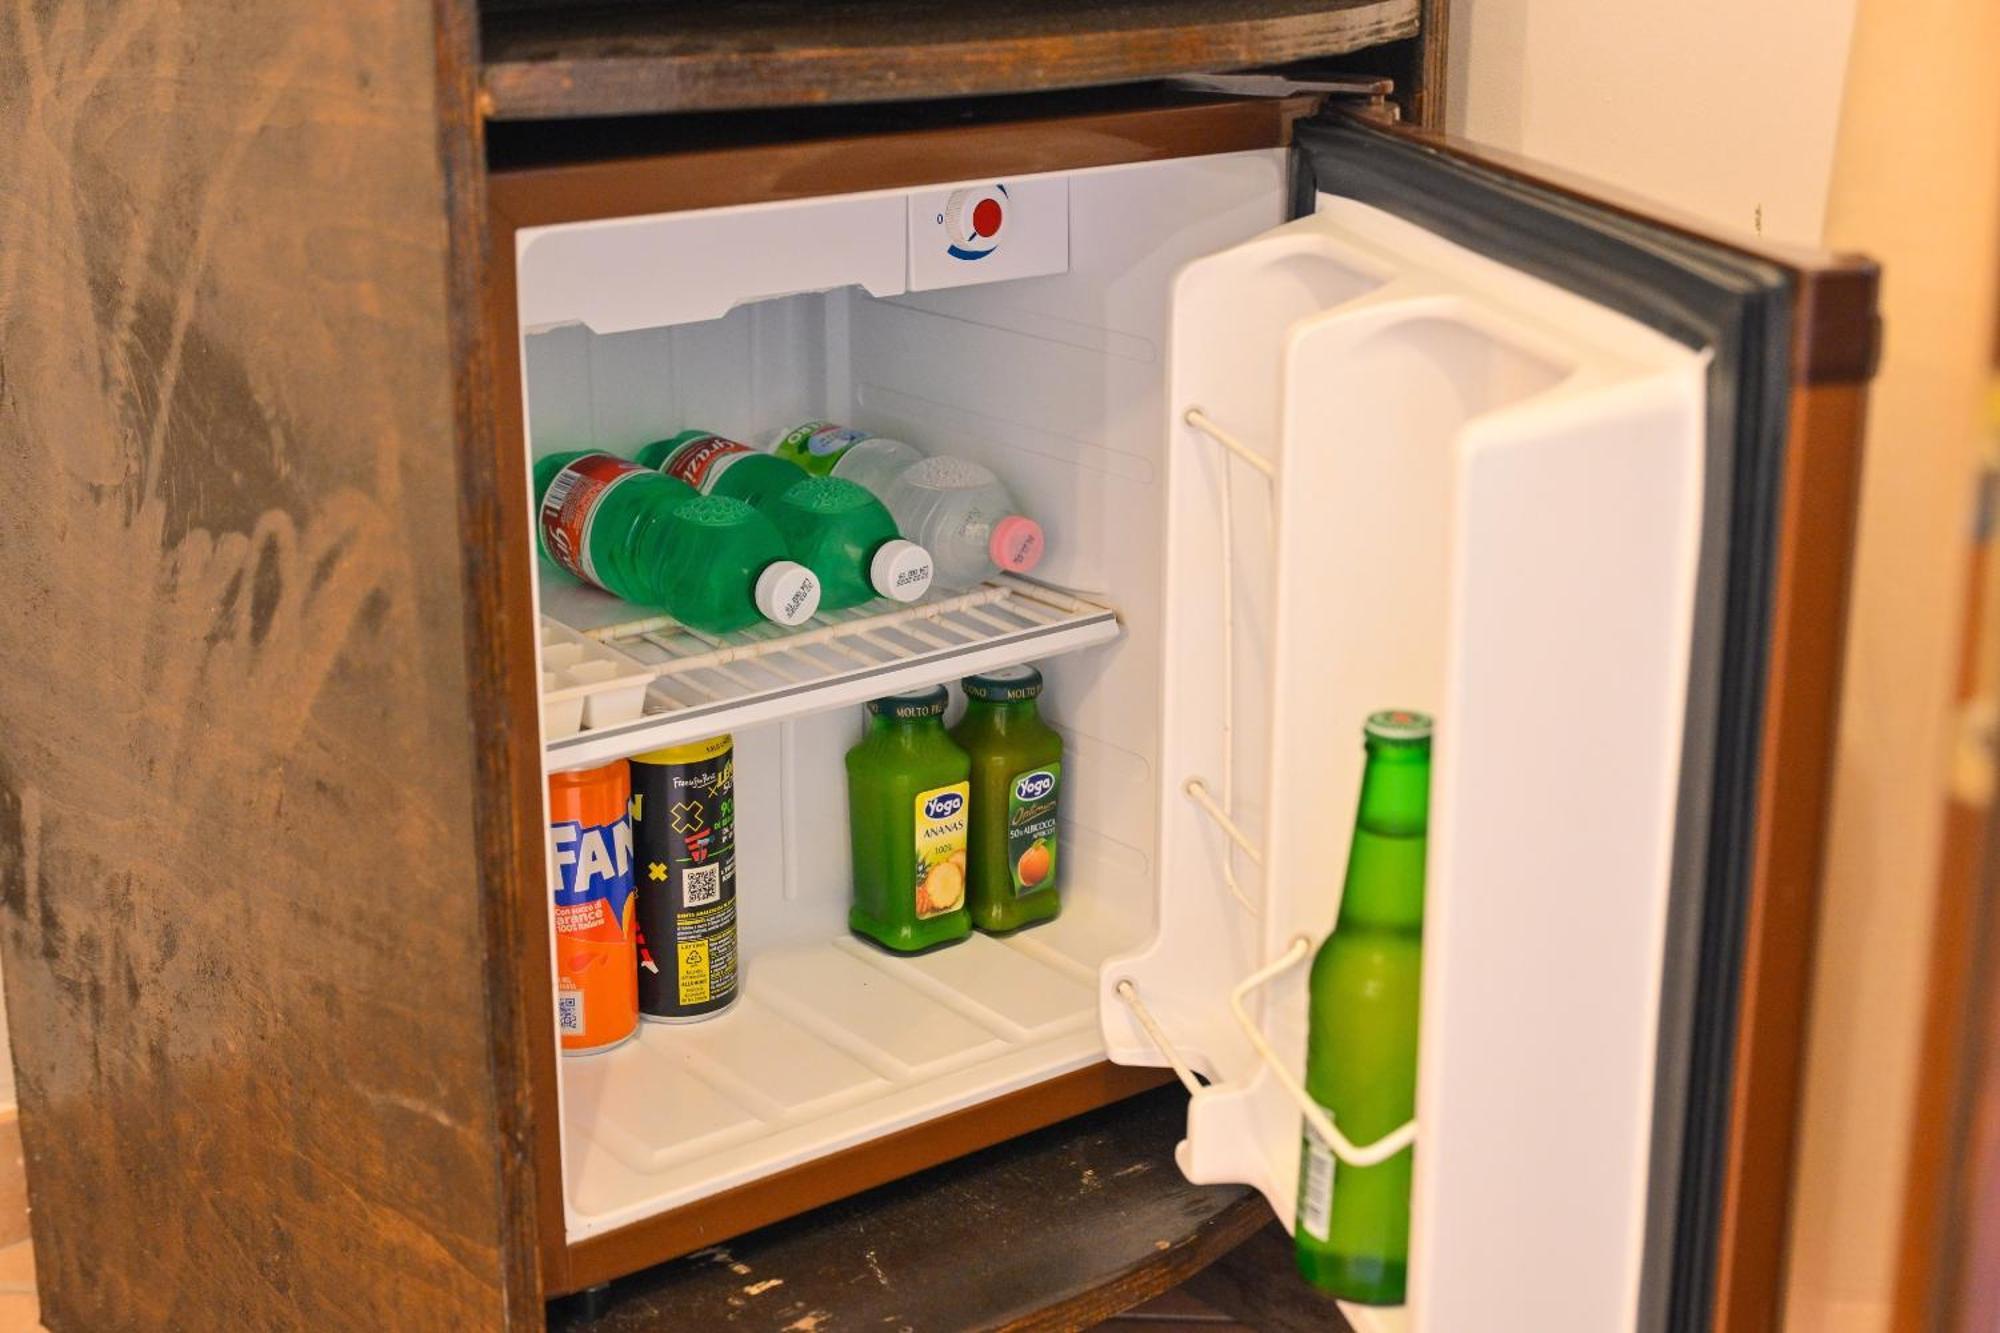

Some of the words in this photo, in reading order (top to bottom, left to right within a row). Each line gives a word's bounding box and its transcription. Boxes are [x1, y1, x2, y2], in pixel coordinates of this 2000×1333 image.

[1007, 687, 1035, 700] MOLTO
[896, 705, 929, 718] MOLTO
[1019, 778, 1051, 797] Yoga
[927, 797, 962, 817] Yoga
[923, 820, 964, 839] ANANAS
